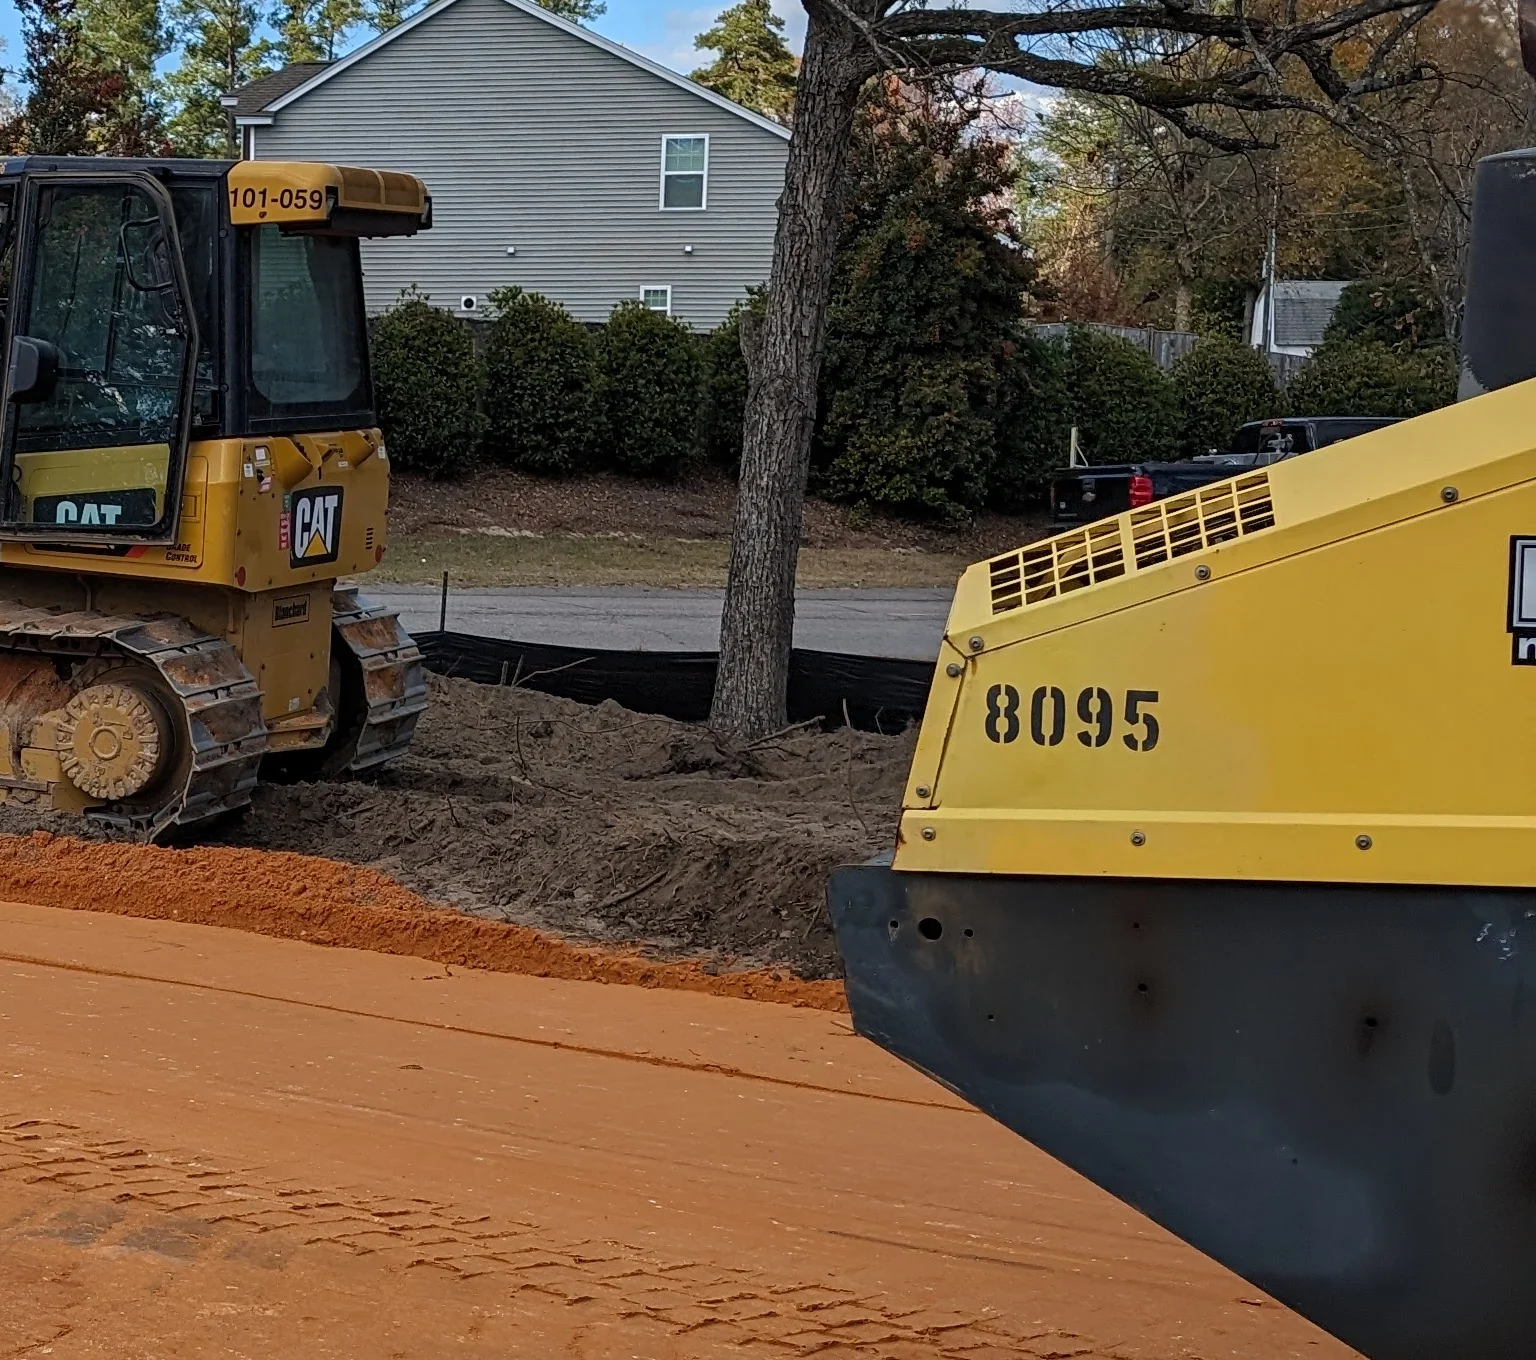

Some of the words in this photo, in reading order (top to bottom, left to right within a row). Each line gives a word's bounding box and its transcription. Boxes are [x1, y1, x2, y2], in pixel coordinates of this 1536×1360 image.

[230, 187, 323, 210] 101-059
[56, 500, 122, 525] CAT
[294, 494, 339, 559] CAT
[275, 600, 308, 621] Blanchard
[985, 683, 1160, 752] 8095
